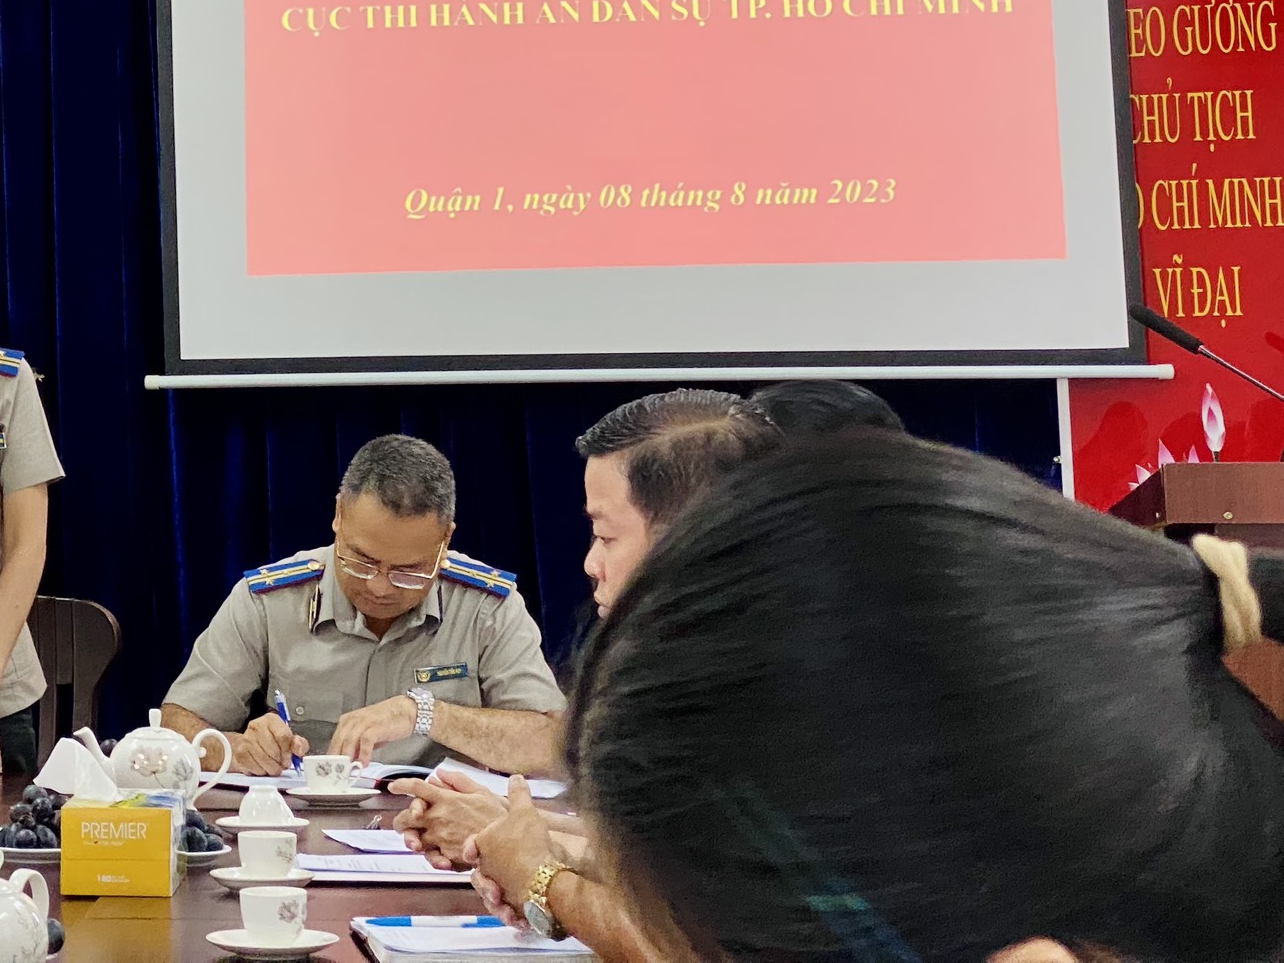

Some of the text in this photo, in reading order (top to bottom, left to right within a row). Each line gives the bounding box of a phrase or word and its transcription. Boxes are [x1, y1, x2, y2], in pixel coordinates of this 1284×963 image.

[281, 6, 351, 37] CỤC
[359, 3, 417, 29] THI
[1187, 90, 1256, 152] TỊCH
[404, 179, 897, 220] Quận 1, ngày 08 tháng 8 năm 2023
[1152, 163, 1201, 230] CHÍ
[1207, 177, 1284, 228] MINH
[1153, 253, 1243, 328] VĨ ĐẠI
[81, 822, 147, 839] PREMIER
